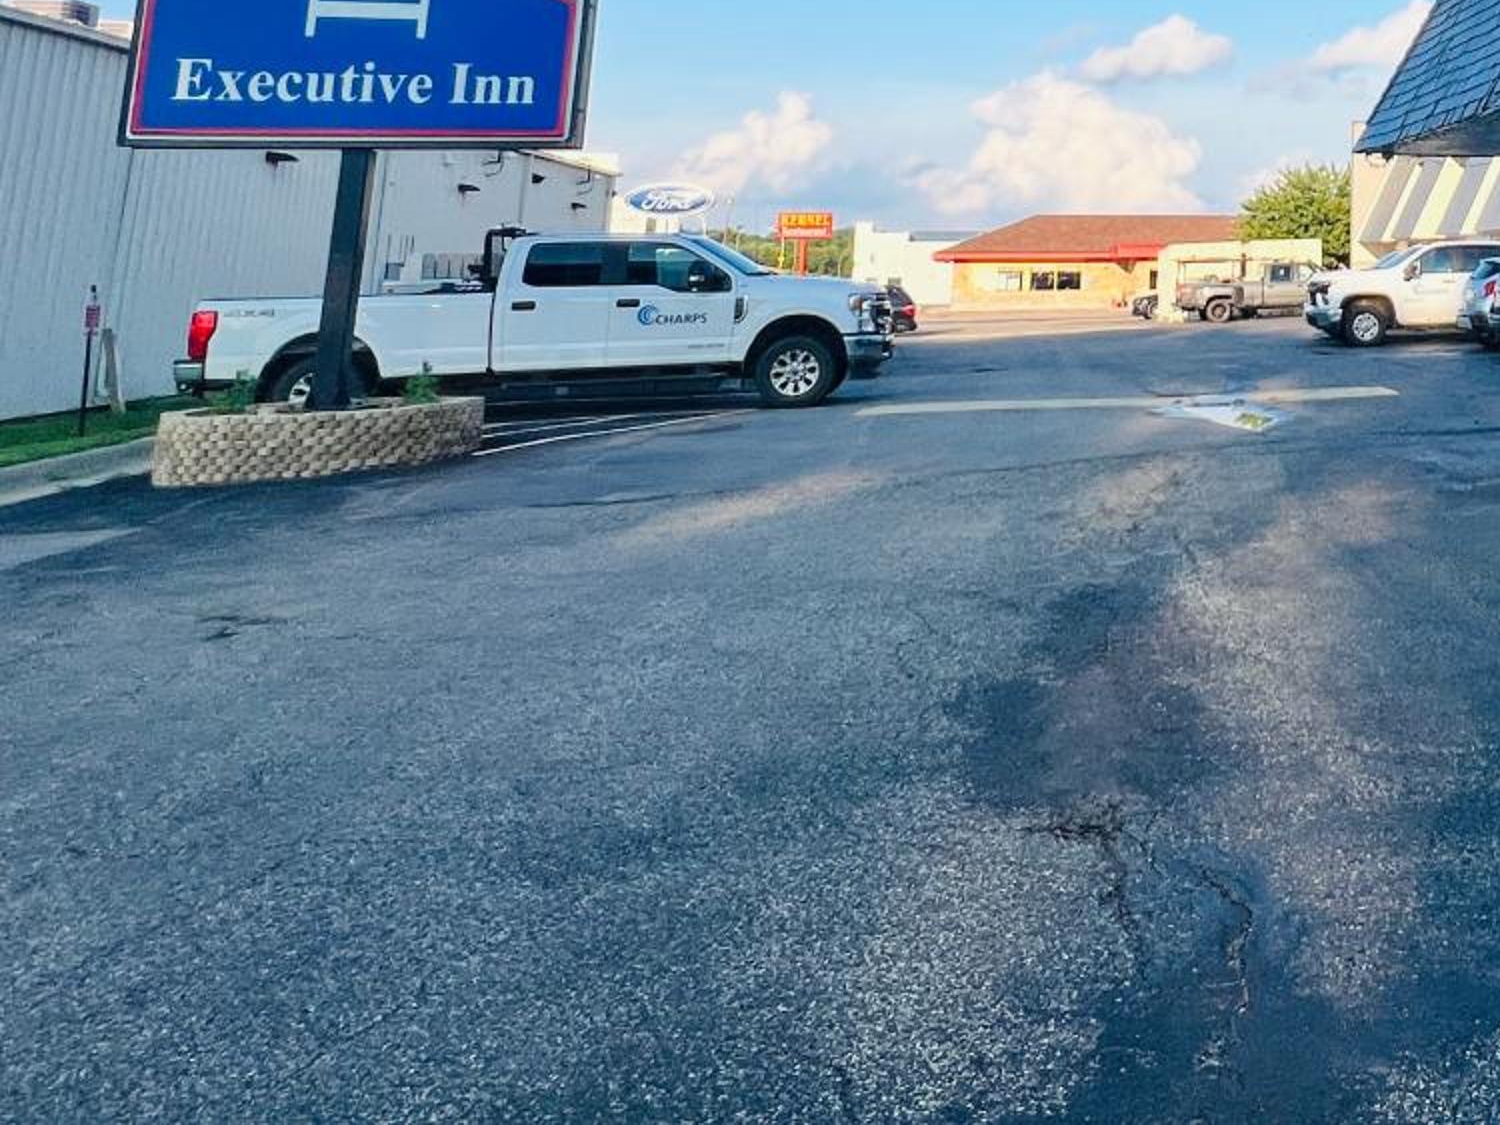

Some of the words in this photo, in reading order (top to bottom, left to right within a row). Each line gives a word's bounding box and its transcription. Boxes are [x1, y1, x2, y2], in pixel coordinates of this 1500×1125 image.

[170, 57, 433, 104] Executive
[449, 62, 535, 105] Inn
[655, 312, 709, 325] CHARPS
